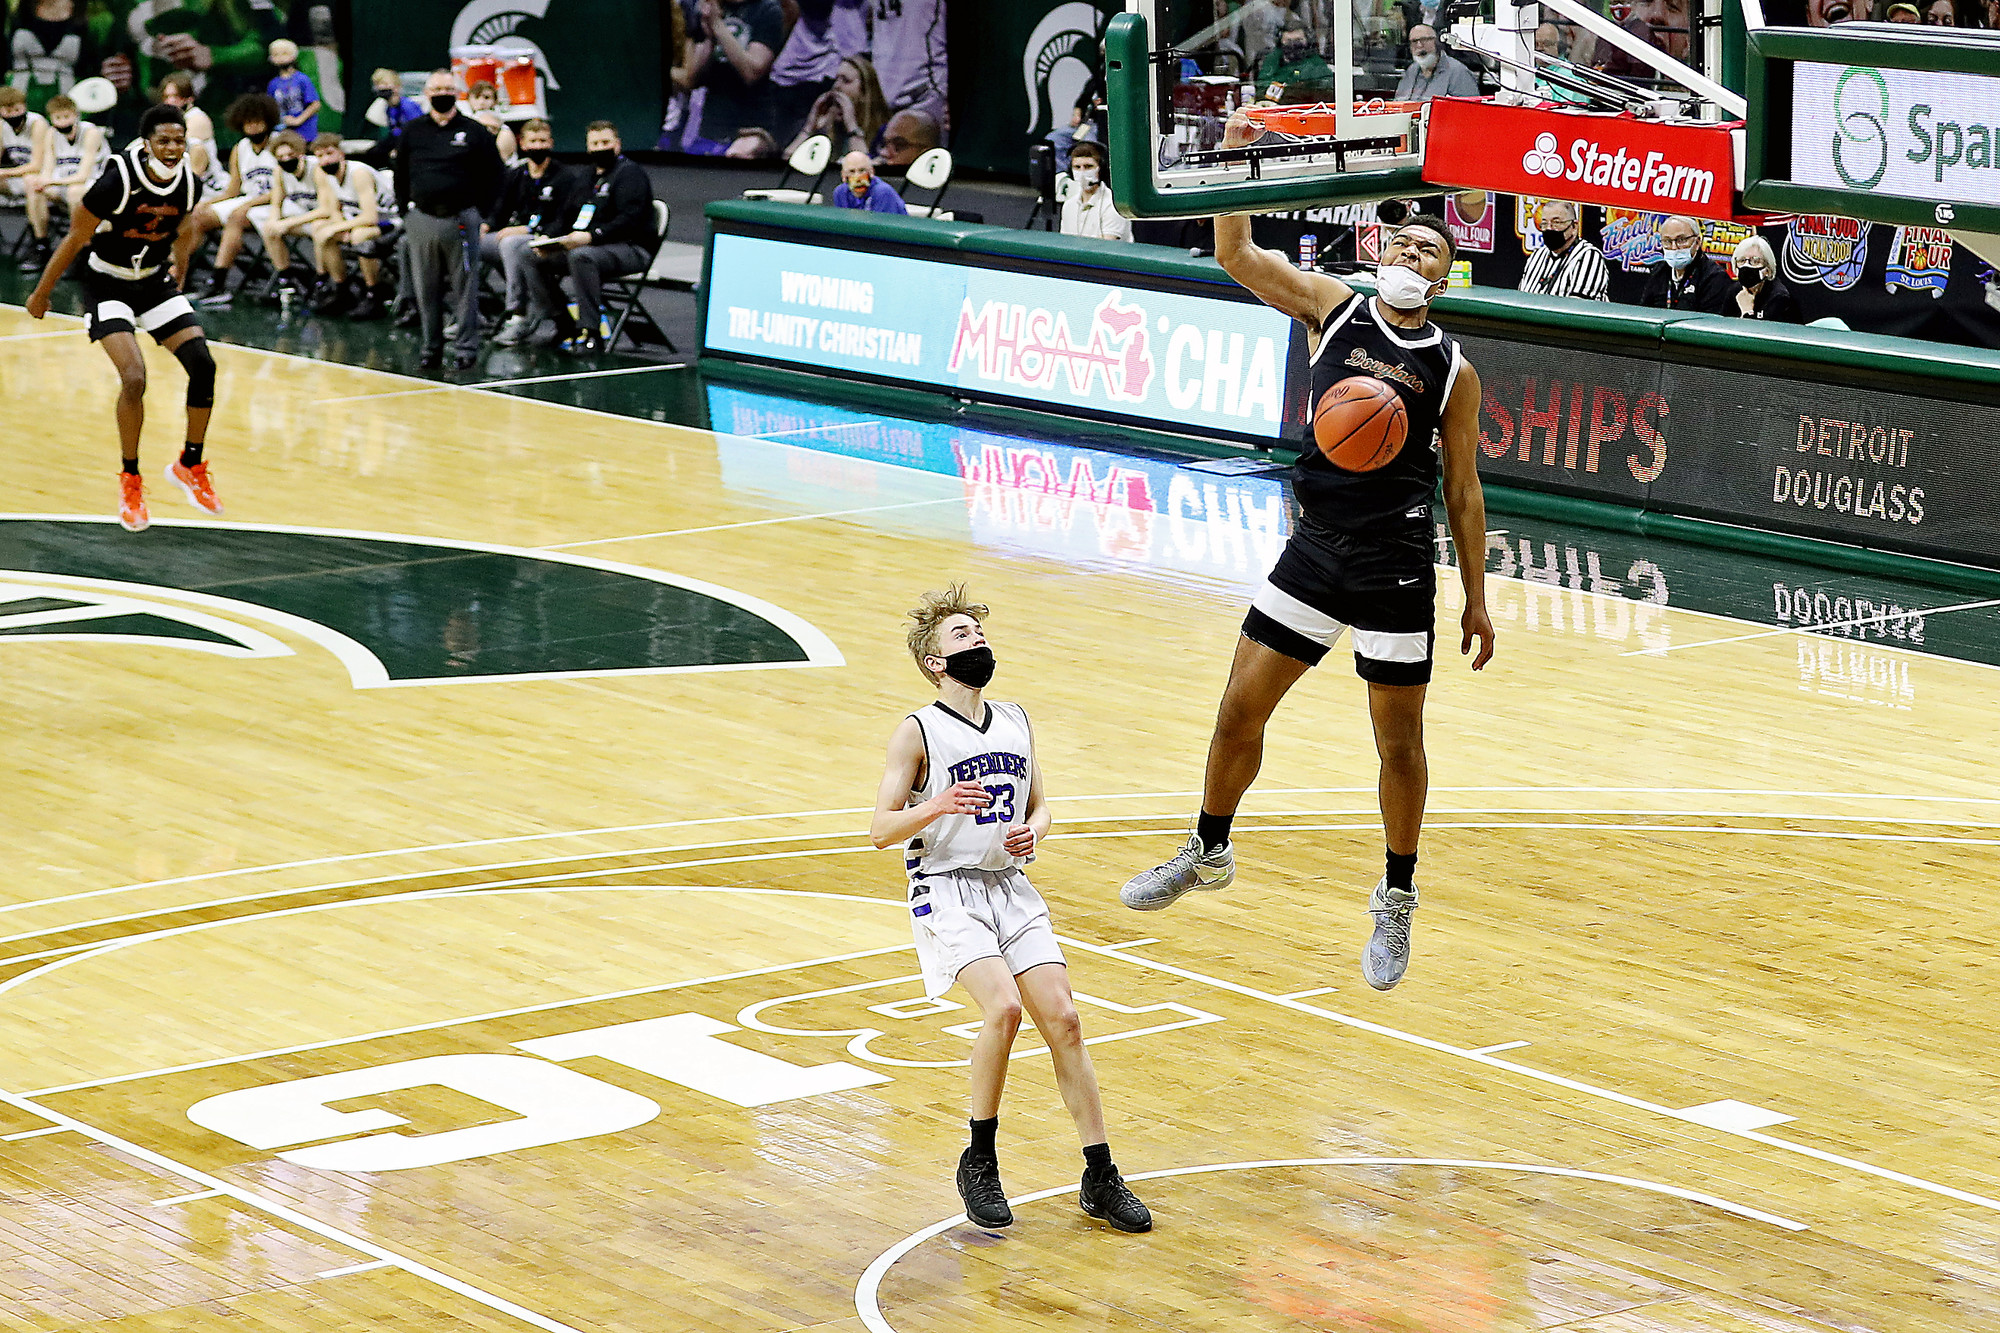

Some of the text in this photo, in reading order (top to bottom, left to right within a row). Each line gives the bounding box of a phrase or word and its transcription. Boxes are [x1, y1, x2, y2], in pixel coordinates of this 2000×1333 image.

[780, 270, 874, 313] WYOMING
[728, 306, 922, 366] TRI-UNITY CHRISTIAN
[1796, 414, 1915, 468] DETROIT
[1773, 465, 1925, 525] DOUGLASS
[948, 752, 1028, 785] DEFENDERS
[974, 782, 1015, 826] 23
